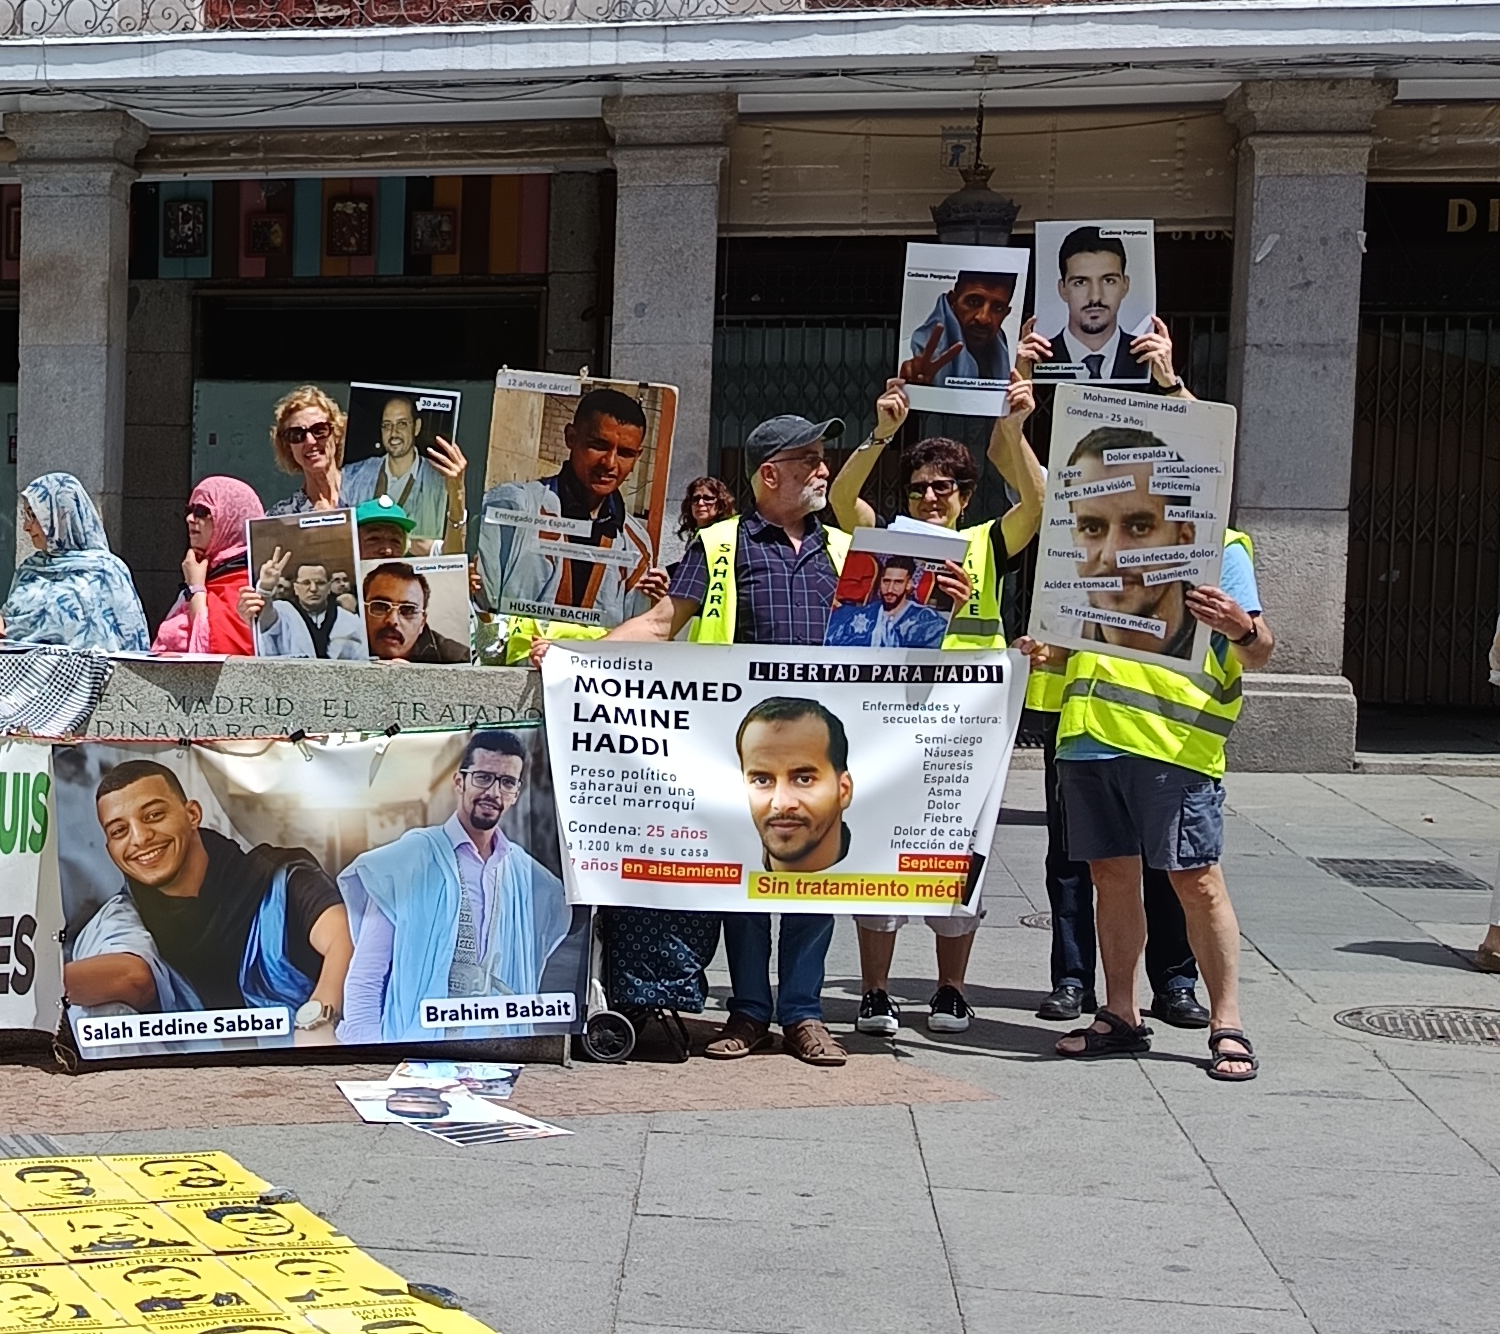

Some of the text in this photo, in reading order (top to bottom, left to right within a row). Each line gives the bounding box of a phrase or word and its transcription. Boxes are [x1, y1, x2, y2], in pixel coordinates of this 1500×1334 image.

[507, 378, 572, 392] 12 años de cárcel
[1083, 393, 1187, 414] Mohamed Lamine Haddi
[1066, 407, 1144, 427] Condena 25 años
[1106, 451, 1131, 461] Dolor
[1132, 449, 1167, 462] espalda
[1058, 470, 1082, 480] fiebre
[1156, 464, 1222, 474] articulaciones.
[1054, 478, 1135, 501] fiebre. Mala visión.
[1151, 480, 1201, 492] septicemia
[494, 510, 576, 531] Entregado por España
[1049, 517, 1076, 527] Asma.
[1167, 509, 1217, 520] Anafilaxia.
[1047, 548, 1085, 560] Enuresis.
[1119, 549, 1218, 564] Oído infectado, dolor,
[707, 543, 731, 618] SAHARA
[1146, 567, 1199, 583] Aislamiento
[1043, 579, 1121, 590] Acidez estomacal.
[509, 601, 601, 622] HUSSEIN BACHIR
[1059, 604, 1162, 632] Sin tratamiento médico
[570, 655, 653, 671] Periodista
[754, 663, 998, 683] LIBERTAD PARA HADDI
[573, 675, 742, 703] MOHAMED
[98, 693, 543, 724] EN MADRID EL TRATADO
[862, 701, 961, 713] Enfermedades y
[572, 702, 690, 730] LAMINE
[882, 715, 1002, 725] secuelas de tortura:
[571, 732, 669, 757] HADDI
[914, 734, 983, 746] Semi-ciego
[924, 747, 974, 758] Náuseas
[570, 765, 677, 782] Preso político
[922, 761, 973, 771] Enuresis
[569, 779, 695, 796] saharaui en una
[923, 774, 970, 785] Espalda
[927, 787, 962, 797] Asma
[569, 792, 696, 813] cárcel marroquí
[927, 800, 961, 810] Dolor
[923, 813, 963, 823] Fiebre
[568, 820, 708, 840] Condena: 25 años
[893, 826, 927, 836] Dolor
[930, 827, 945, 837] de
[578, 840, 610, 851] 1.200
[616, 842, 633, 853] km
[640, 843, 654, 855] de
[660, 846, 675, 856] su
[680, 847, 709, 857] casa
[890, 839, 964, 850] Infección de
[580, 858, 619, 871] años
[623, 863, 643, 873] en
[647, 864, 739, 878] aislamiento
[757, 877, 790, 894] Sin
[796, 878, 910, 896] tratamiento
[426, 999, 572, 1023] Brahim Babait
[82, 1013, 284, 1042] Salah Eddine Sabbar
